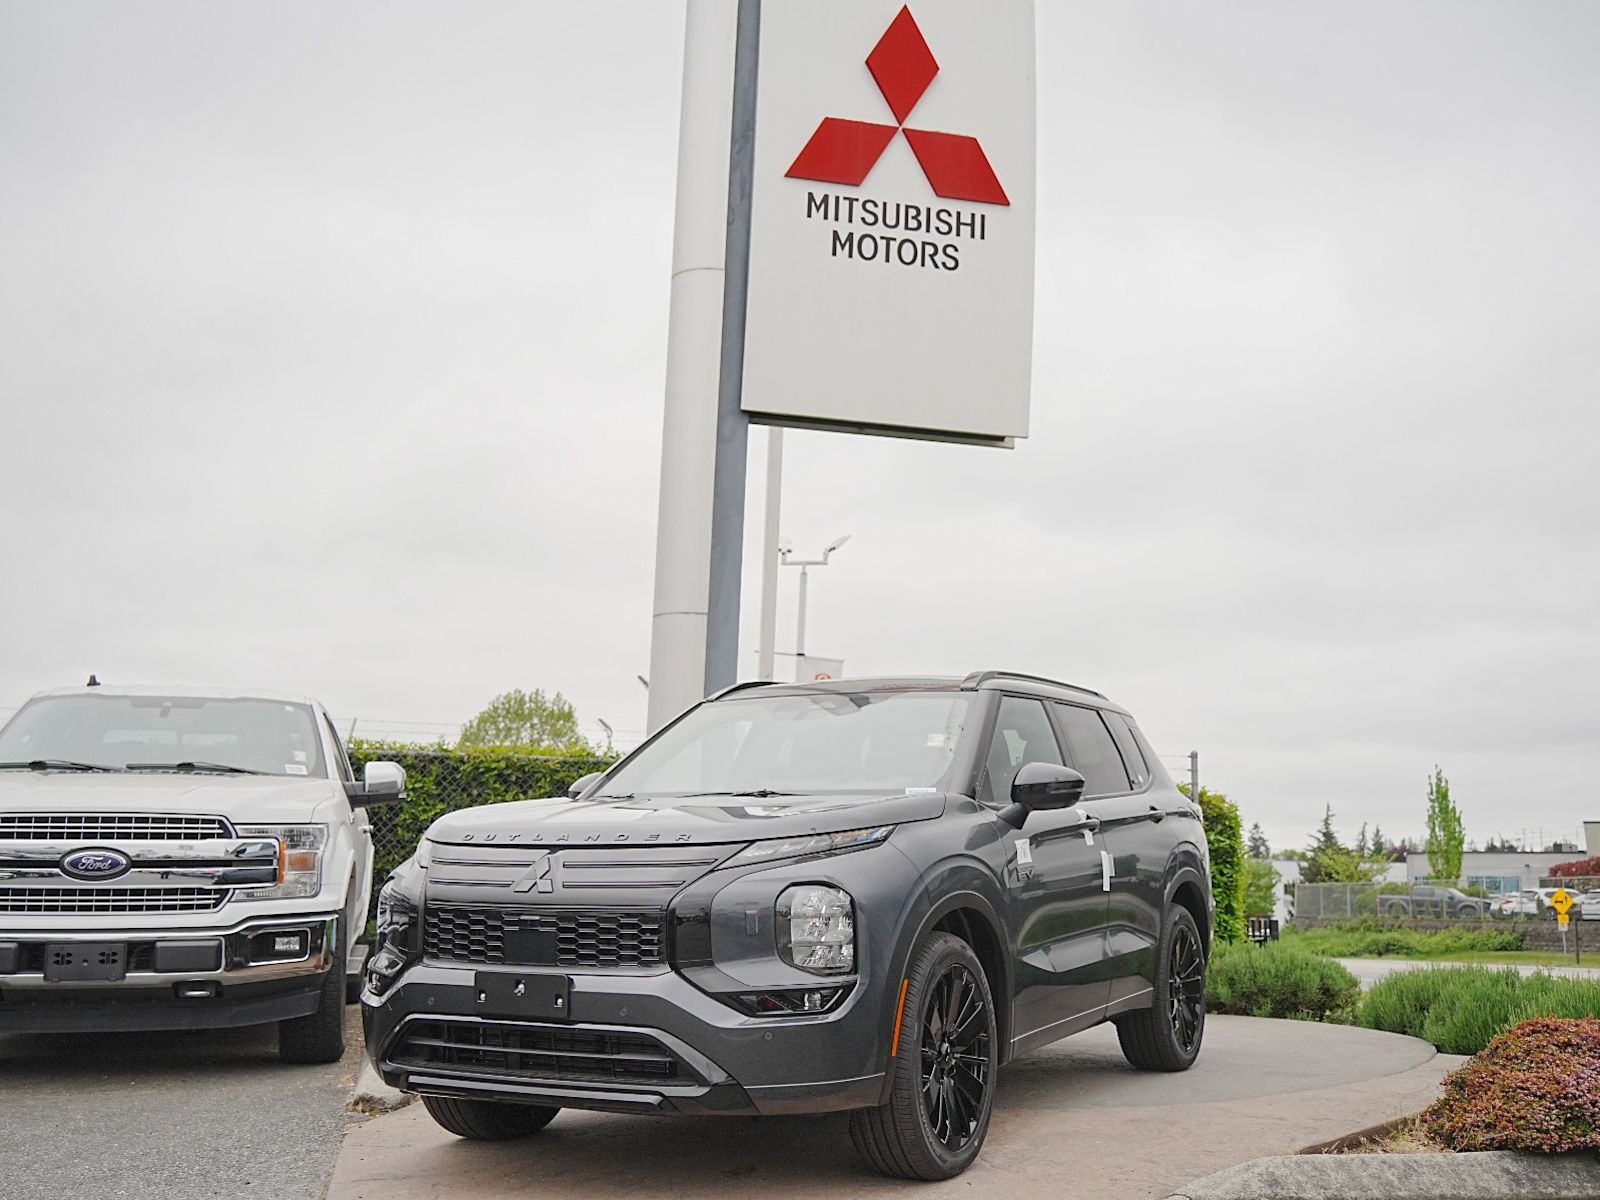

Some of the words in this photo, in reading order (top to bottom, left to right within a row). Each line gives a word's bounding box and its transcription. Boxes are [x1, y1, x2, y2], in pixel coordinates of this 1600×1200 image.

[806, 191, 986, 240] MITSUBISHI
[832, 230, 960, 271] MOTORS
[462, 832, 693, 843] OUTLANDER
[78, 856, 112, 870] Ford
